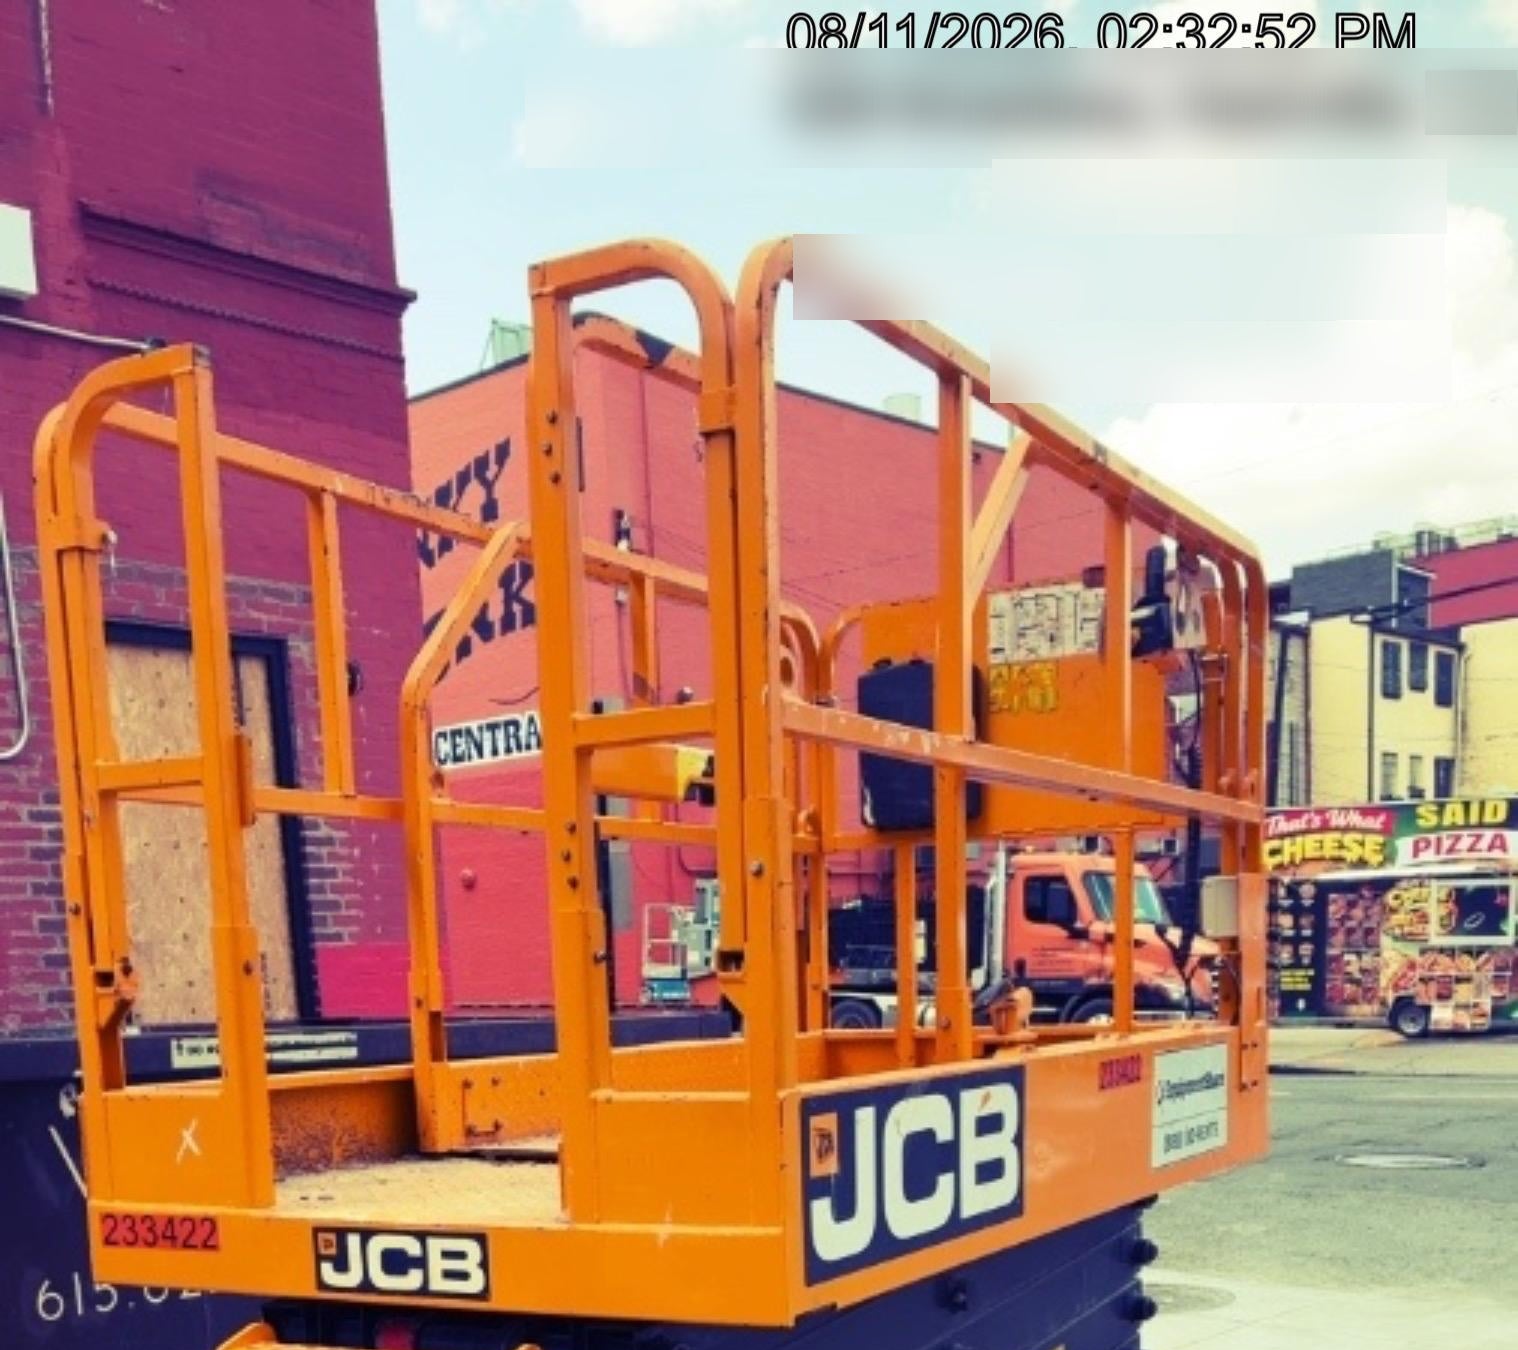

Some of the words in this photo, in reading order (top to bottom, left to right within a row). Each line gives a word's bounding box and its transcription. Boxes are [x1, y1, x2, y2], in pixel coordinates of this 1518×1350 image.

[434, 714, 541, 765] CENTRA
[1325, 808, 1387, 832] What
[1414, 799, 1508, 829] SAID
[1261, 832, 1386, 869] CHEESE
[1411, 832, 1508, 859] PIZZA
[810, 1082, 1019, 1262] JCB
[102, 1214, 217, 1249] 233422
[319, 1231, 486, 1294] JCB
